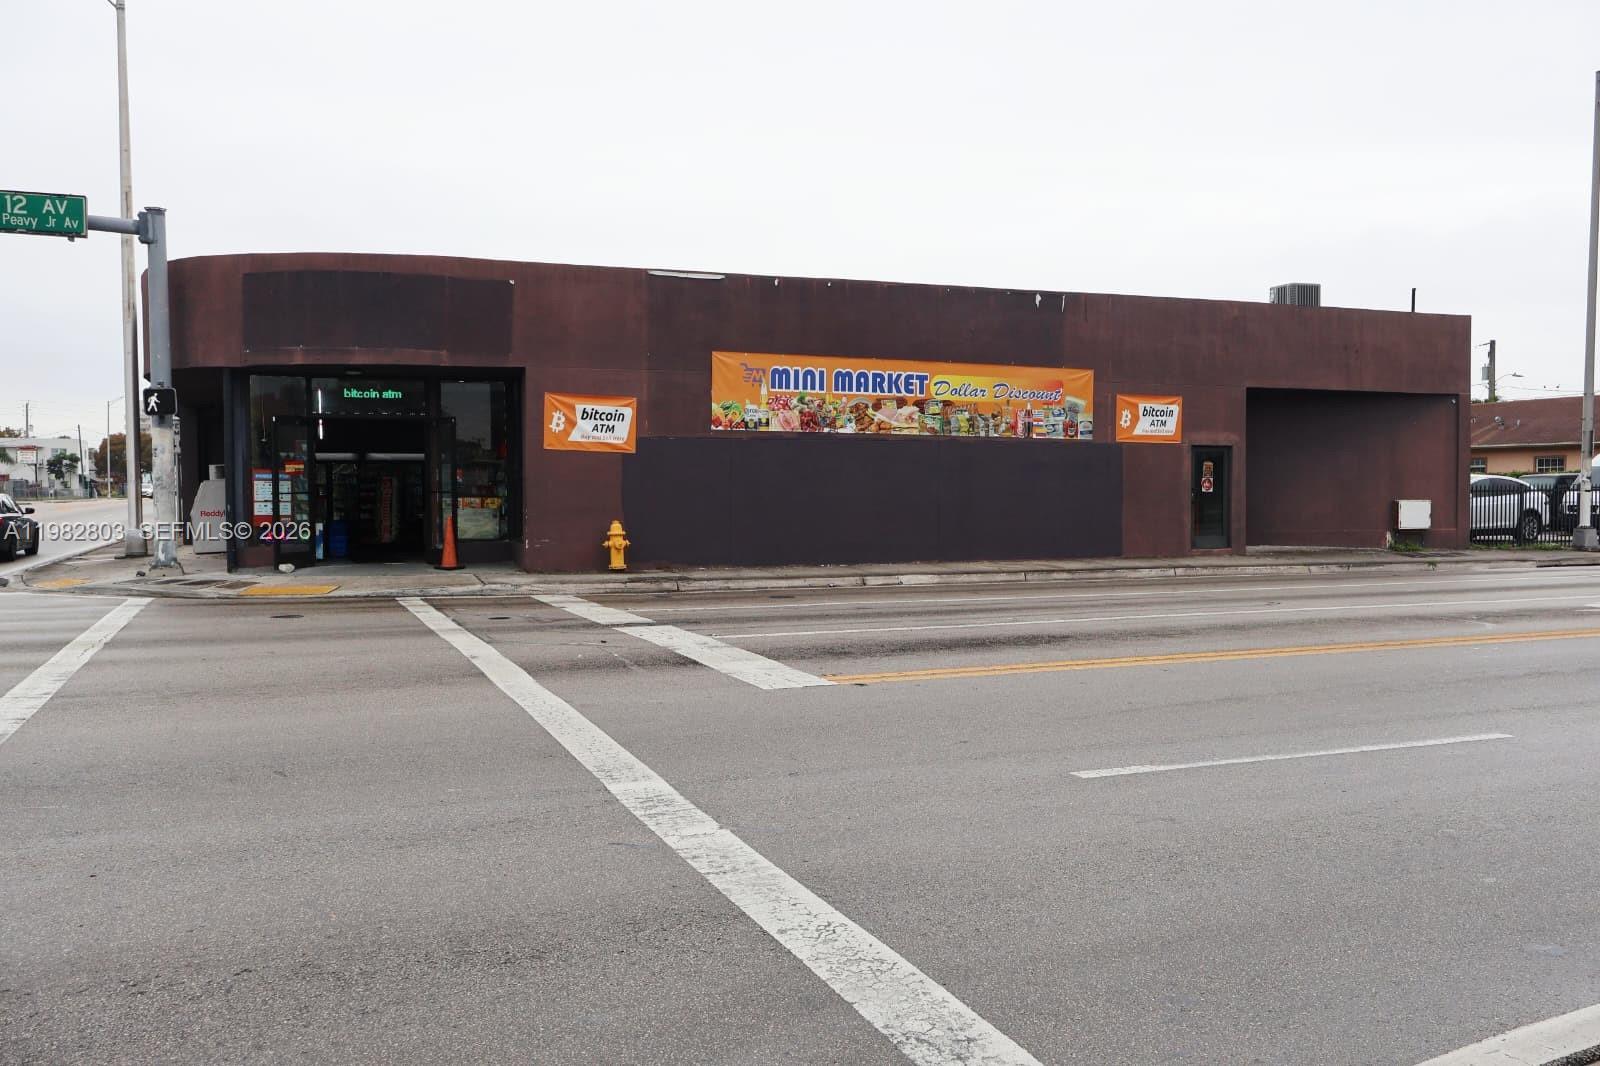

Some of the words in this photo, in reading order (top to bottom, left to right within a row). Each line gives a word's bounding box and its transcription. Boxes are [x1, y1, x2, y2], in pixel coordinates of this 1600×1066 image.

[4, 195, 28, 214] 12
[42, 199, 68, 215] AV
[2, 213, 38, 229] Peavy
[45, 215, 57, 228] Jr
[63, 217, 79, 229] Av
[769, 366, 826, 393] MINI
[832, 368, 929, 397] MARKET
[343, 387, 380, 399] bitcoin
[382, 389, 402, 399] atm
[933, 380, 987, 396] Dollar
[992, 382, 1062, 401] Discount
[580, 407, 625, 422] bitcoin
[1142, 405, 1174, 418] bitcoin
[591, 423, 615, 434] ATM
[1149, 419, 1167, 428] ATM
